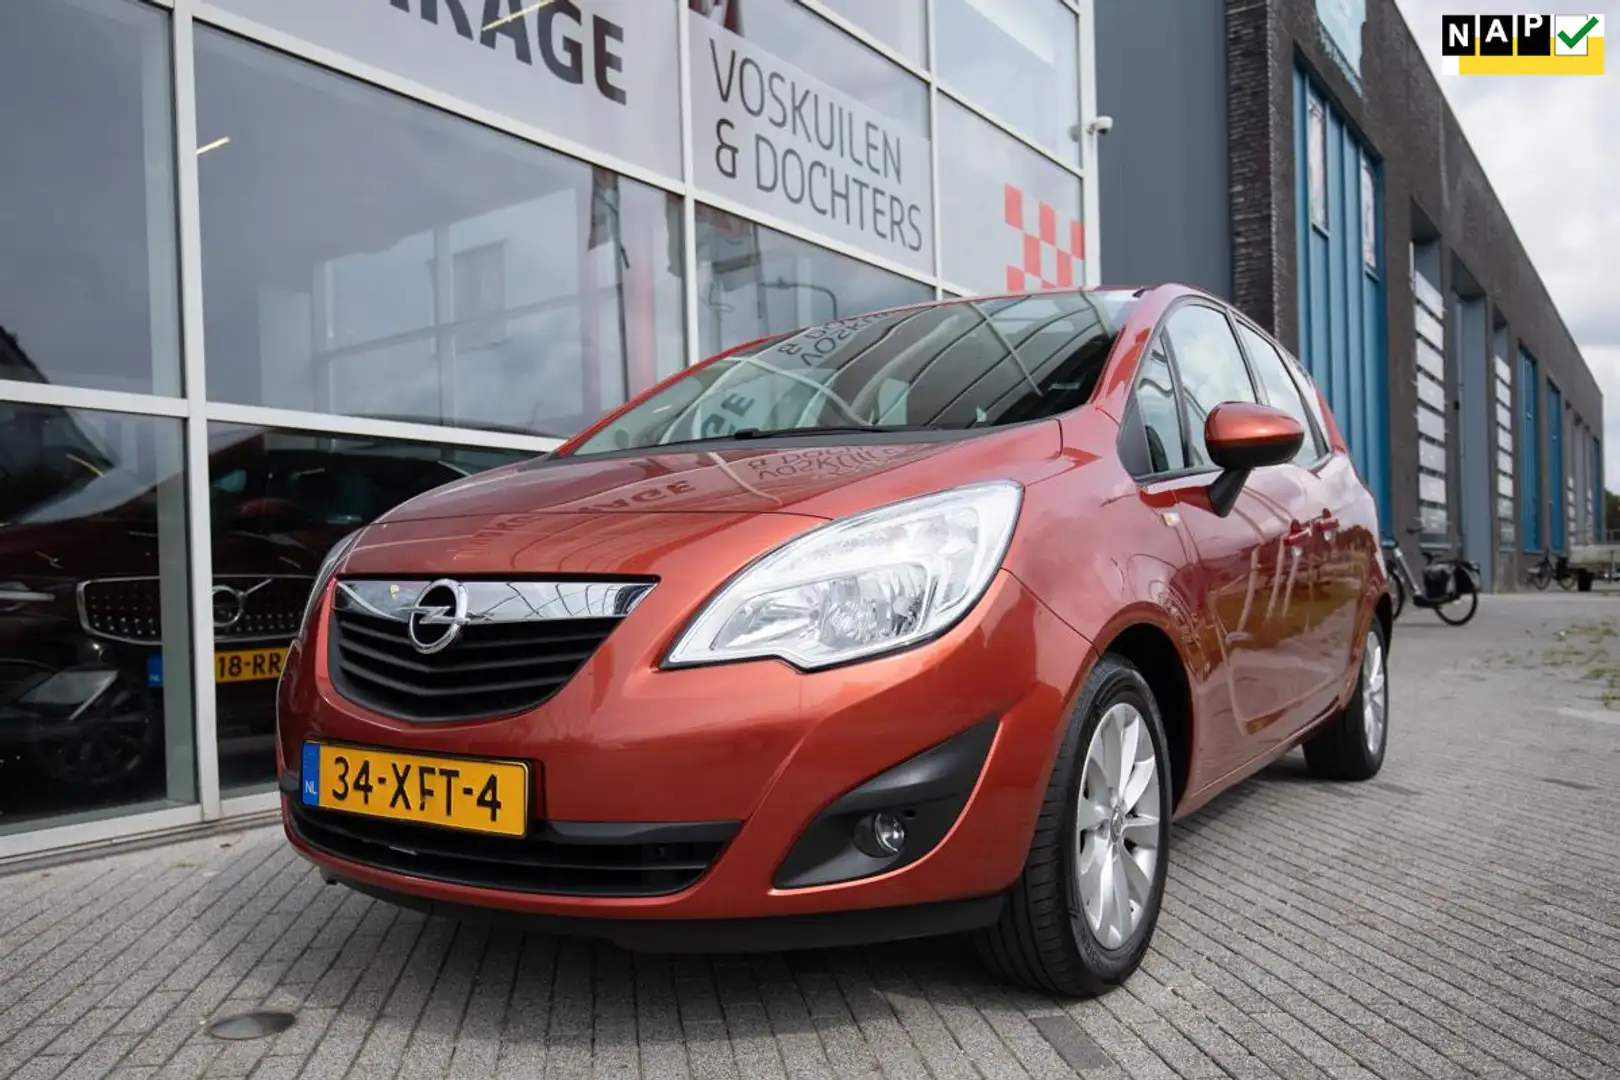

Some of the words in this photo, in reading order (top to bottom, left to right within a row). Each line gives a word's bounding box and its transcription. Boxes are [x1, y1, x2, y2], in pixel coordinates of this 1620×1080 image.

[709, 37, 901, 185] VOSKUILEN
[715, 118, 739, 179] &
[755, 133, 922, 252] DOCHTERS
[305, 779, 317, 795] NL
[331, 756, 502, 822] 34-XFT-4
